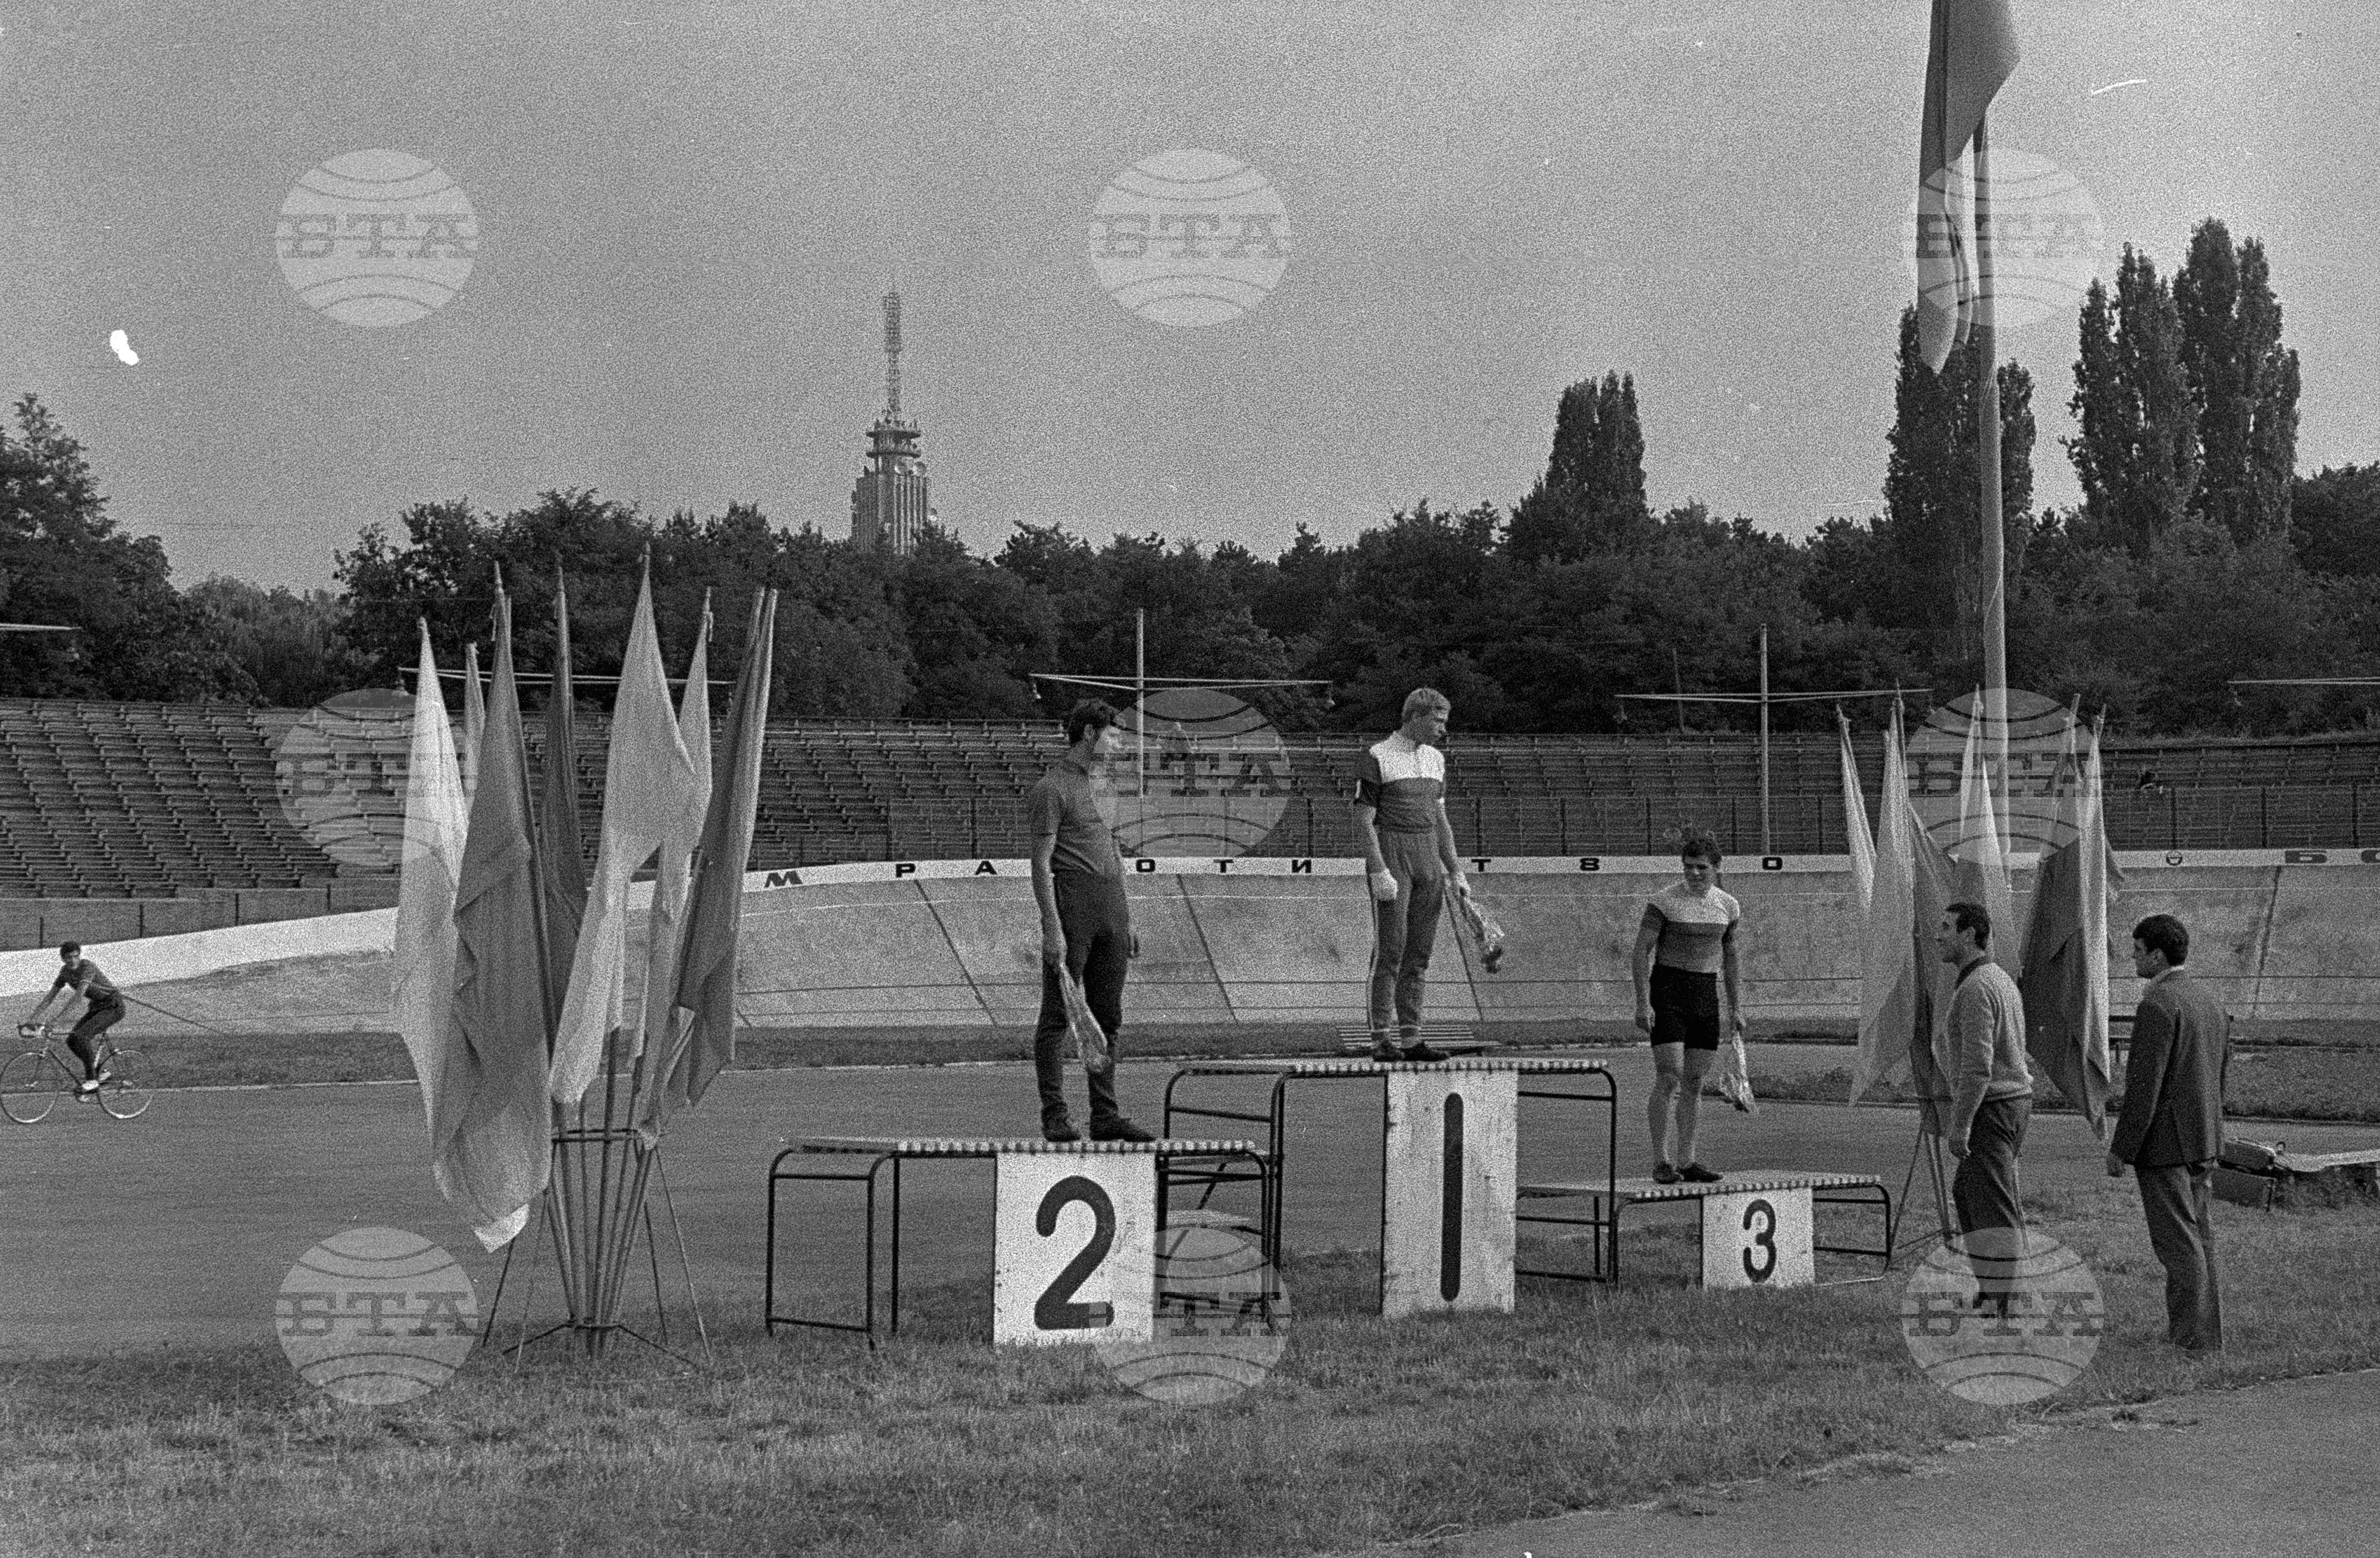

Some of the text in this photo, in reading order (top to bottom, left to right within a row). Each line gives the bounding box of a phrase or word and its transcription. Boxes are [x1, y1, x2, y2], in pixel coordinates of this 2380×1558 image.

[1034, 1175, 1116, 1330] 2
[1440, 1093, 1463, 1302] 1
[1743, 1199, 1776, 1283] 3
